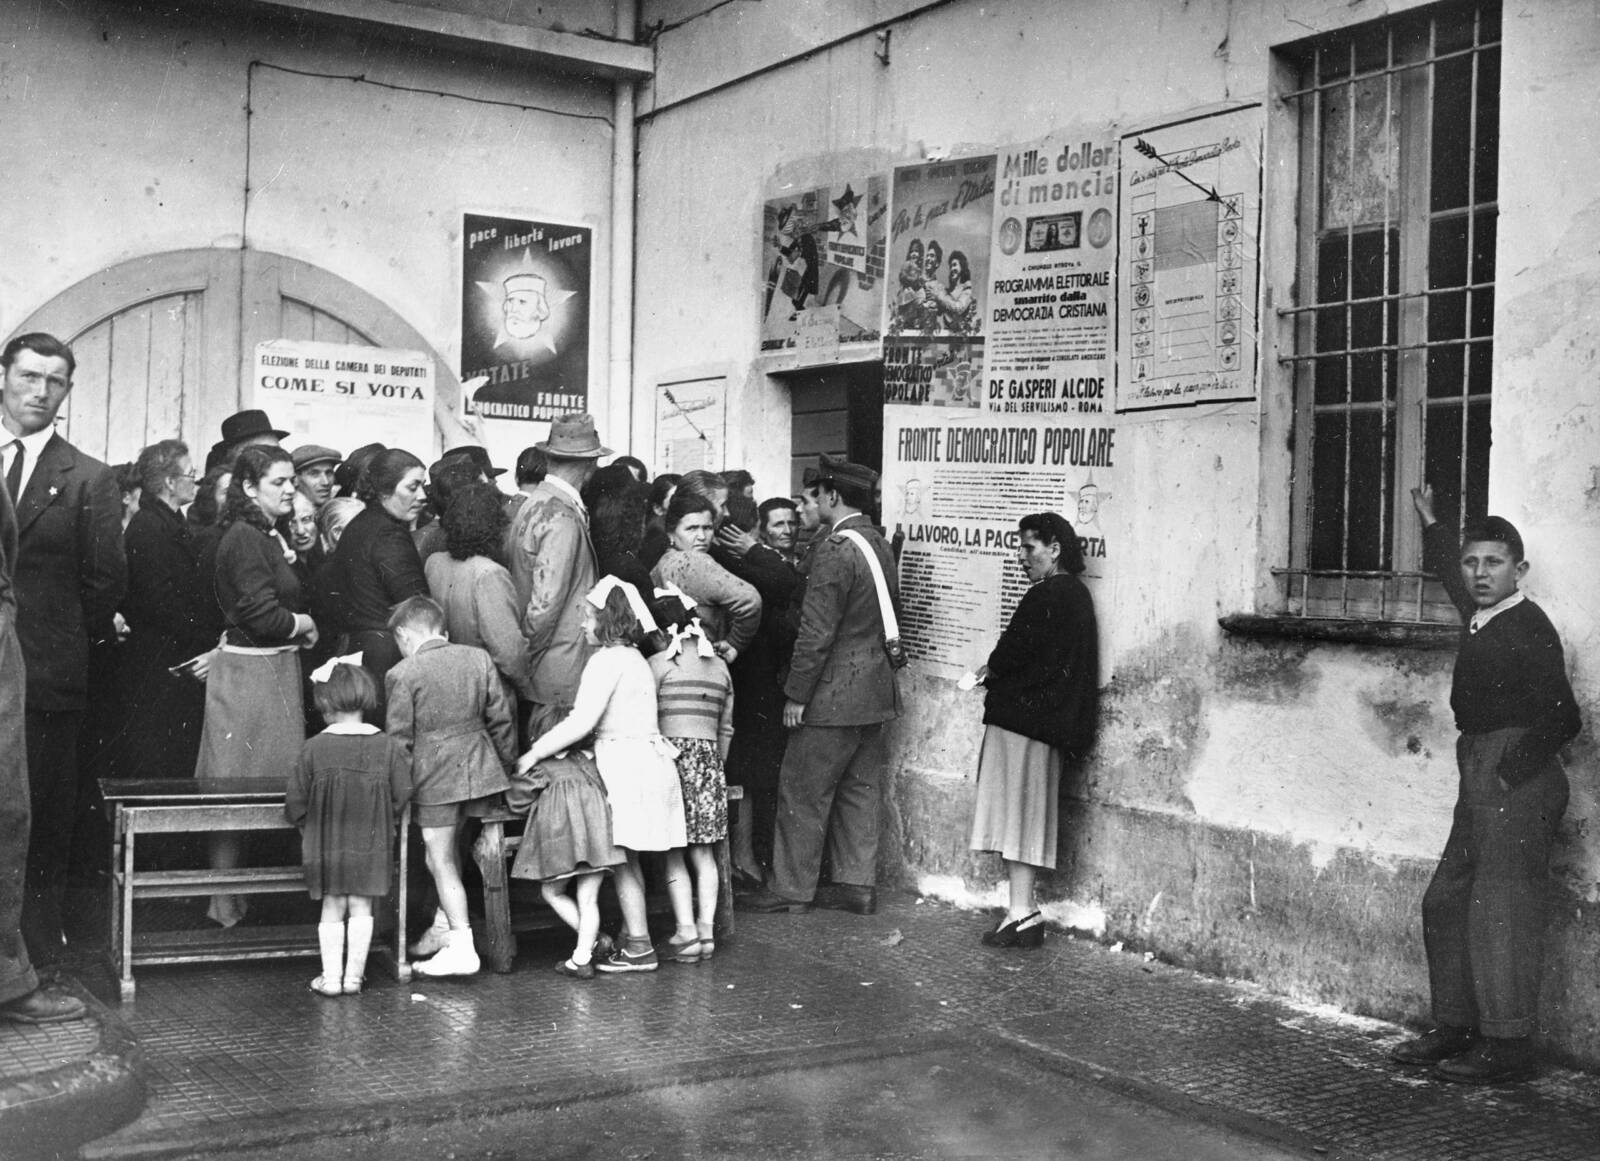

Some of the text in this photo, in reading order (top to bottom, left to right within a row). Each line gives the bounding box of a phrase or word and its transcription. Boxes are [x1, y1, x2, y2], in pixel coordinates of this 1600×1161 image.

[1003, 150, 1048, 179] Mille
[1000, 170, 1114, 206] di mancia
[470, 226, 582, 251] pace libertà lavoro
[994, 271, 1109, 294] PROGRAMMA ELETTORALE
[1014, 291, 1087, 305] smarrito dalla
[993, 302, 1107, 322] DEMOCRAZIA CRISTIANA
[261, 355, 427, 378] ELEZIONE DELLA CAMERA DEI DEPUTATI
[261, 375, 425, 400] COME SI VOTA
[989, 377, 1105, 399] DE GASPERI ALCIDE
[537, 392, 584, 408] FRONTE
[989, 402, 1002, 412] VIA
[1004, 402, 1018, 413] DEL
[1021, 402, 1068, 413] SERVILISMO
[1078, 402, 1102, 413] ROMA
[898, 428, 1116, 467] FRONTE DEMOCRATICO POPOLARE
[908, 524, 962, 548] LAVORO,
[965, 528, 982, 547] LA
